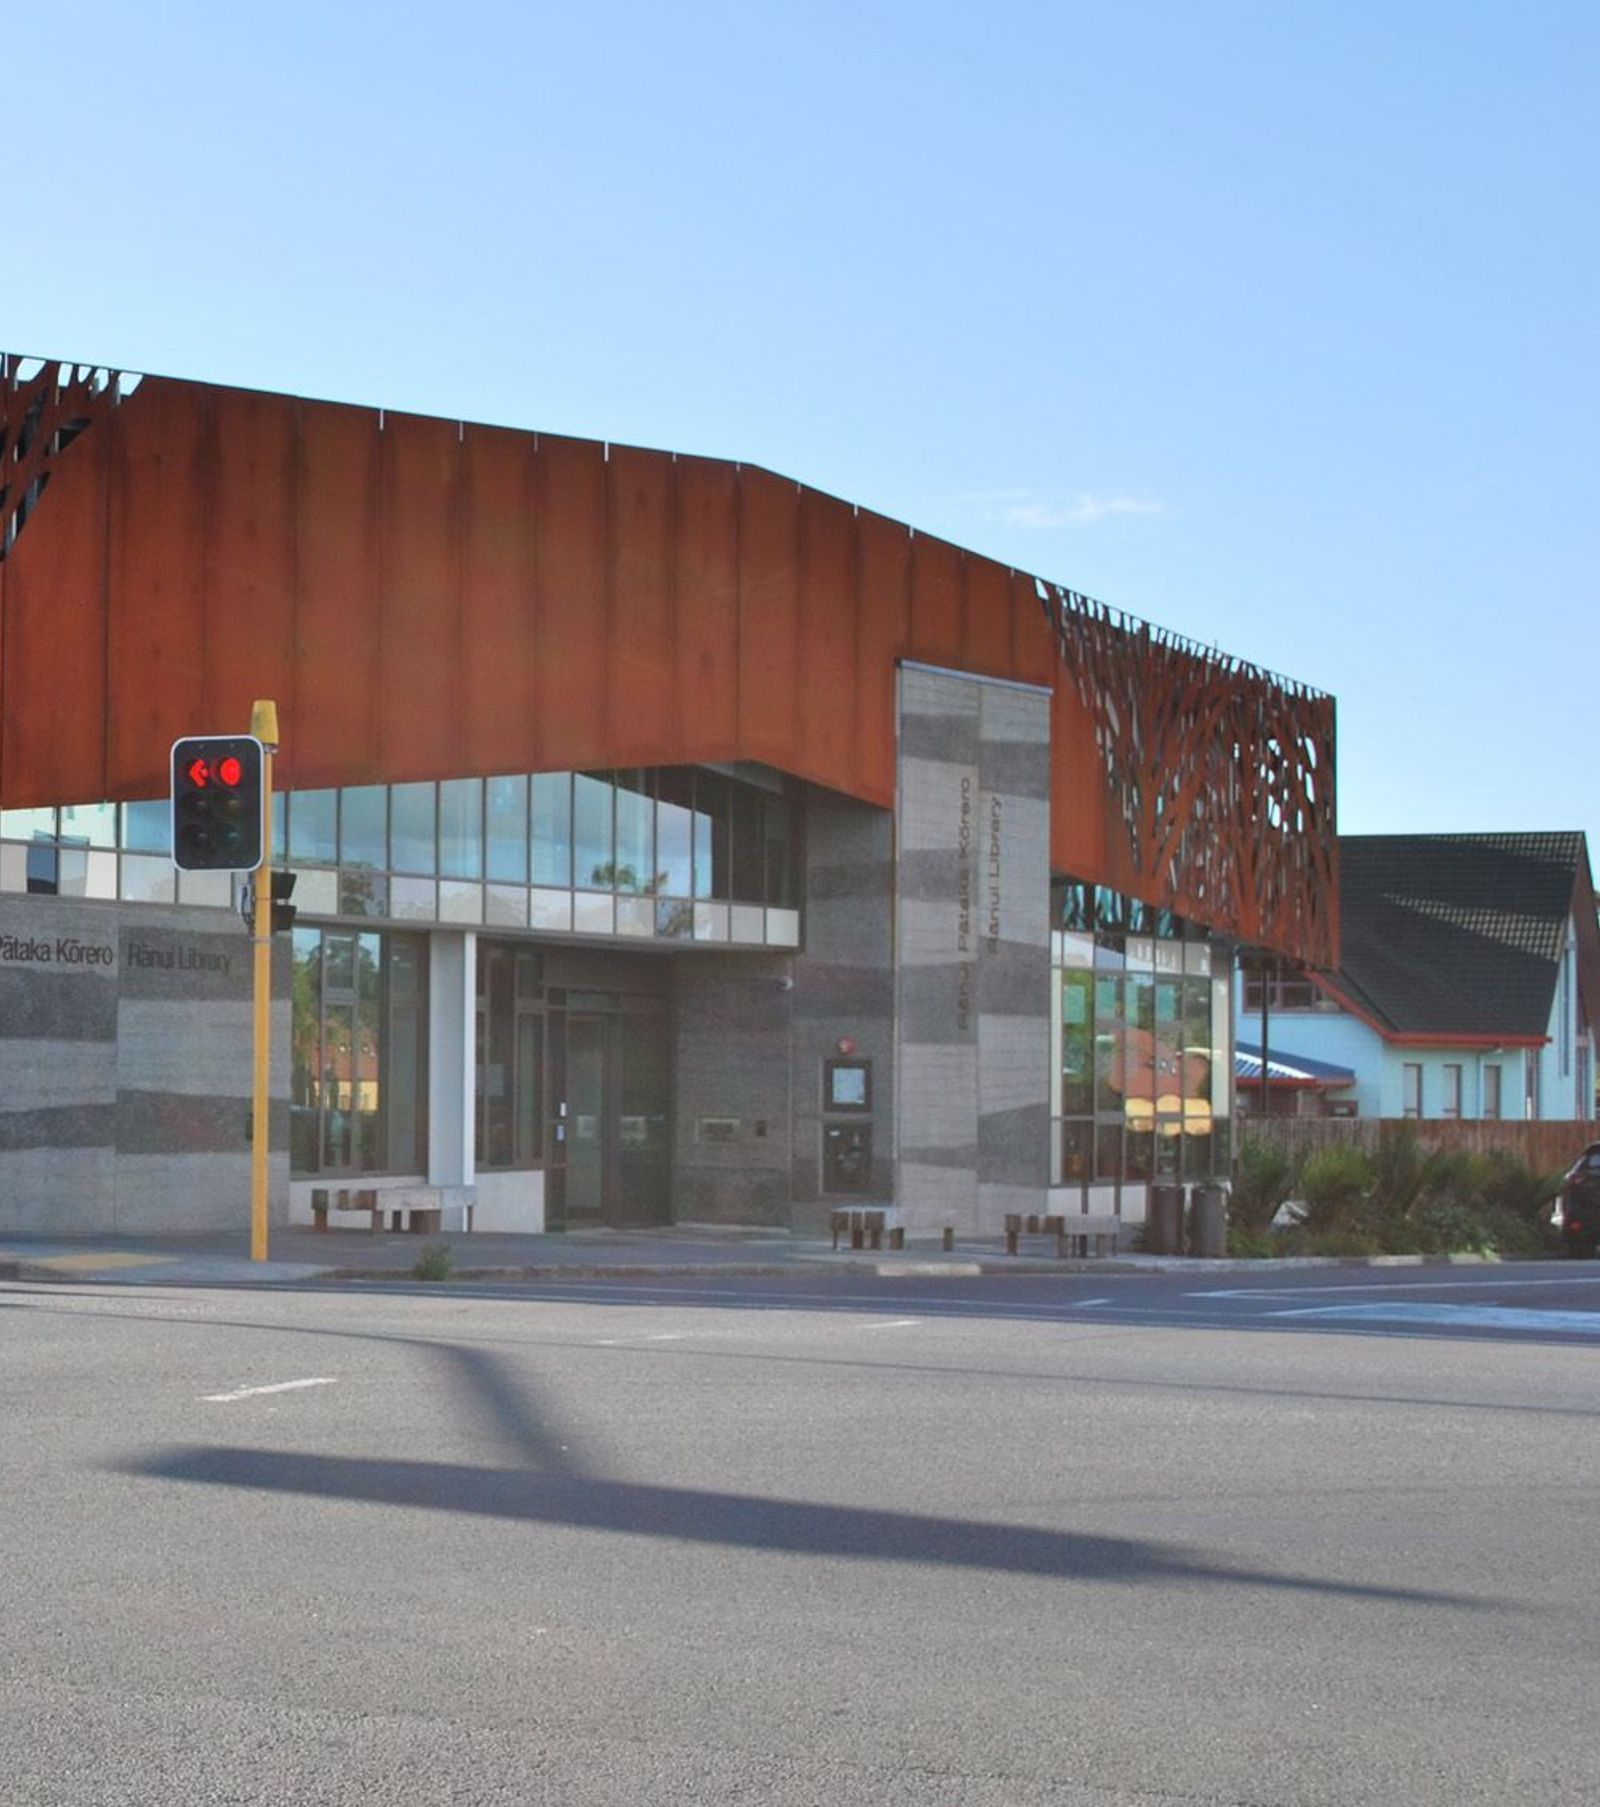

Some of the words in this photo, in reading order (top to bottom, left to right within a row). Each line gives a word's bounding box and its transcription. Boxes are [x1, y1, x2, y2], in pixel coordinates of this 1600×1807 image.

[988, 796, 1001, 876] Library
[56, 938, 114, 966] Kōrero
[178, 950, 232, 977] Library
